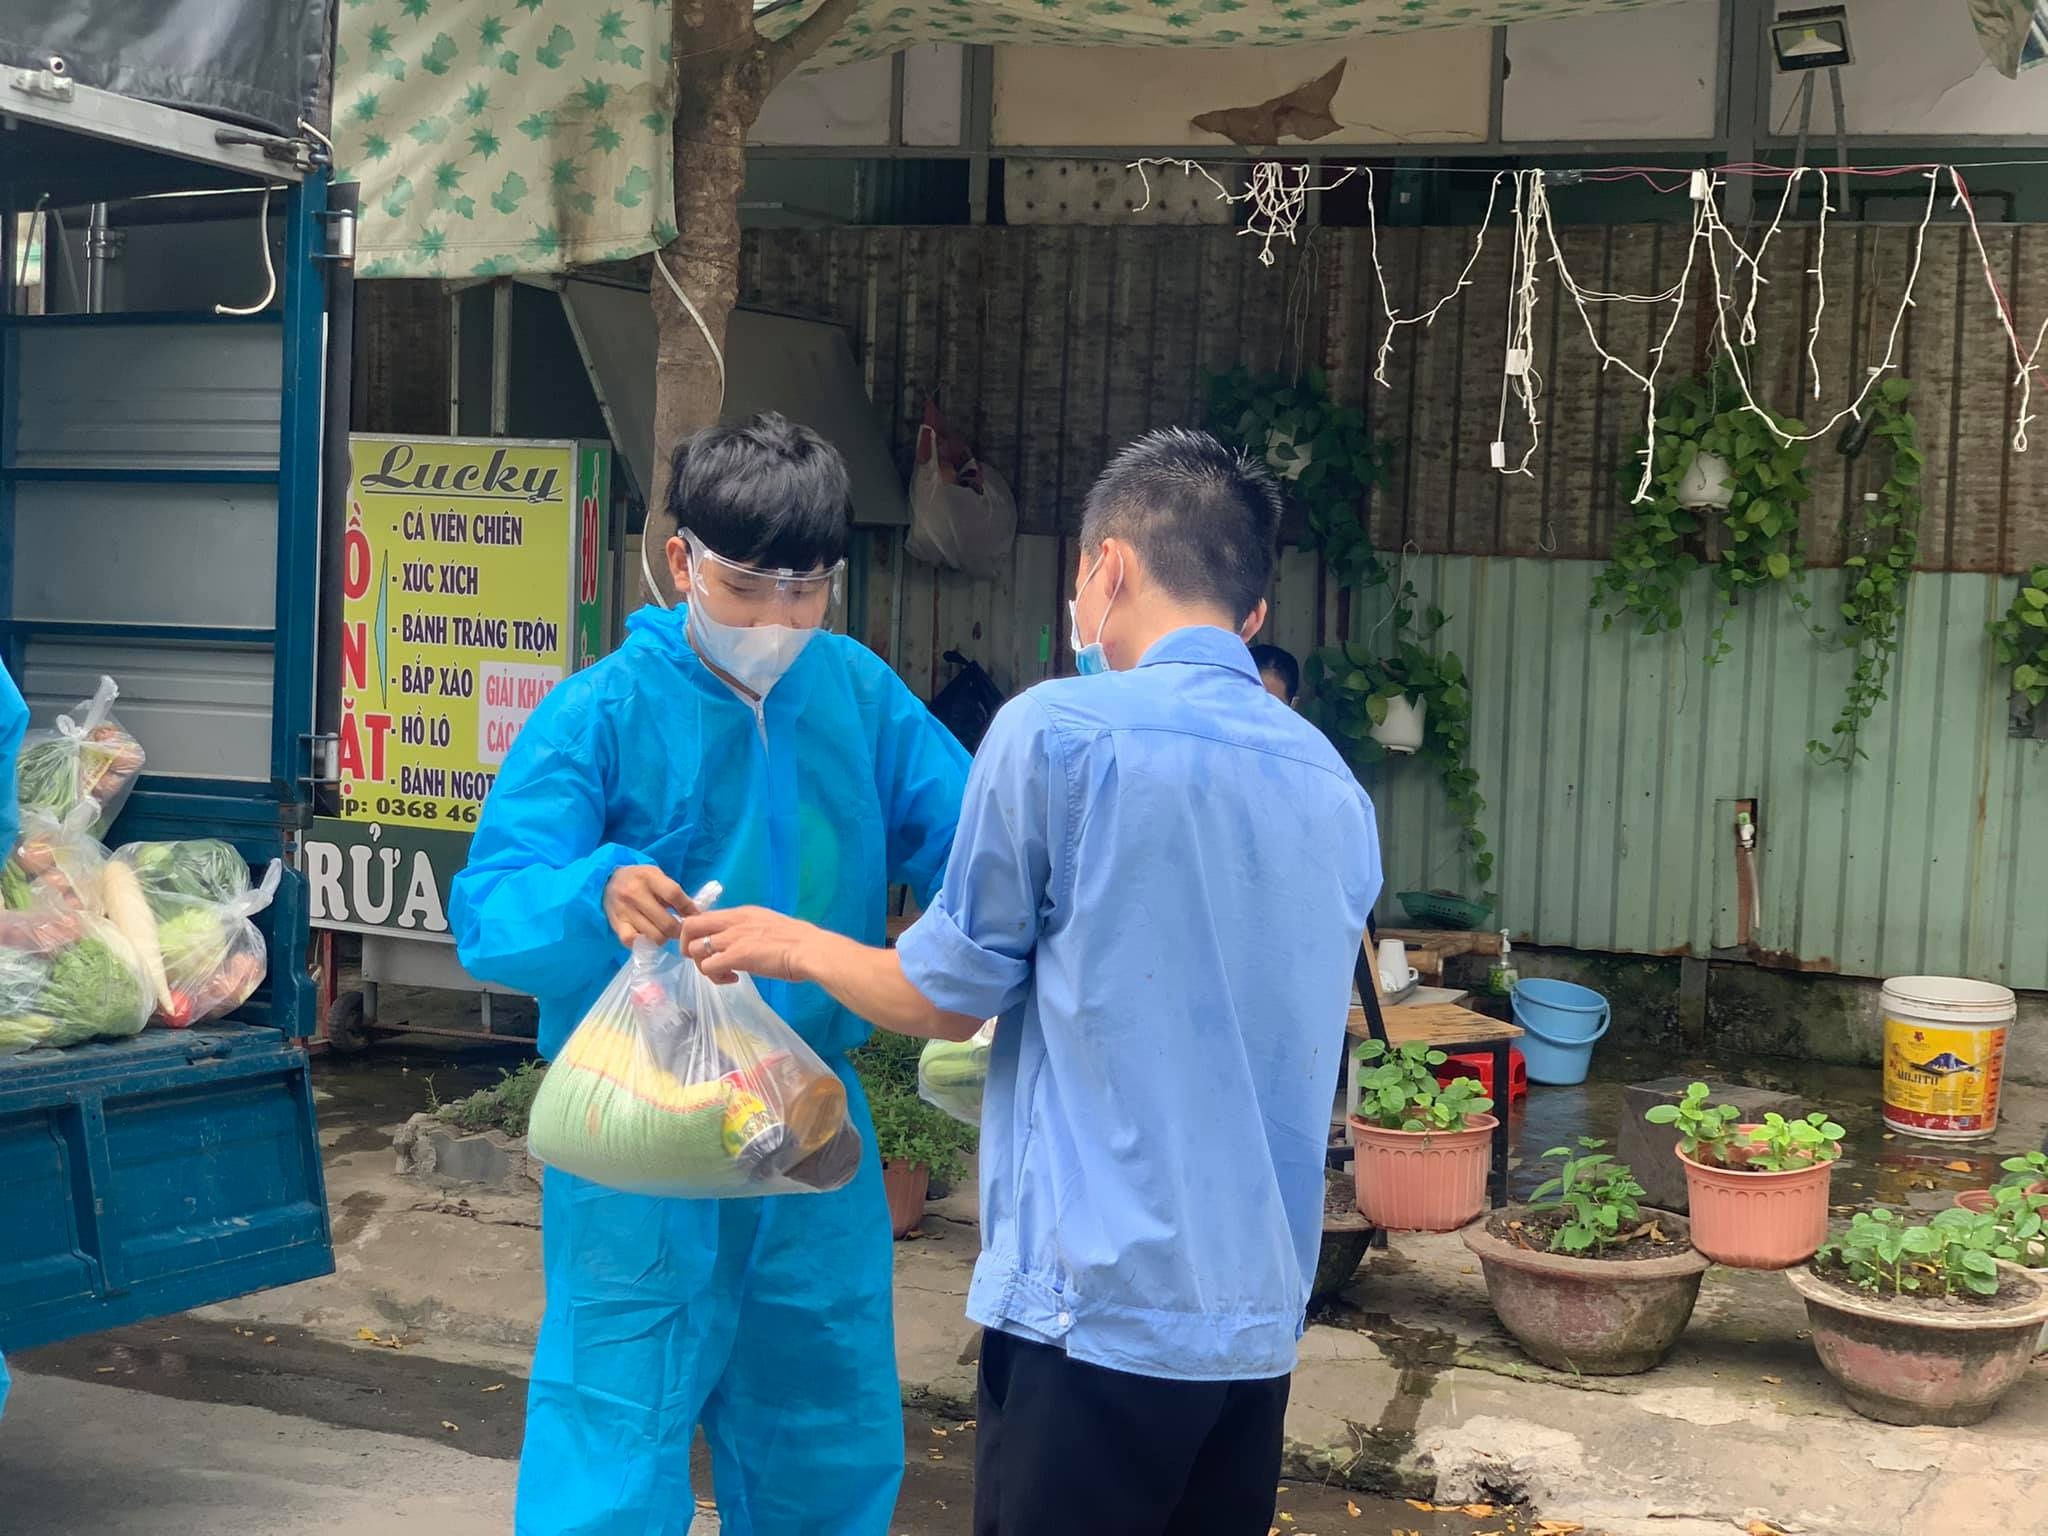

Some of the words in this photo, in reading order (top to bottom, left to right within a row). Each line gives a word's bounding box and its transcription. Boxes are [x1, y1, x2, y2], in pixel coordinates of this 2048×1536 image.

[361, 445, 562, 503] Lucky
[403, 507, 425, 541] CÁ
[430, 508, 467, 542] VIÊN
[473, 510, 522, 545] CHIÊN
[402, 557, 434, 592] XÚC
[439, 560, 478, 595] XÍCH
[402, 609, 447, 644] BÁNH
[453, 612, 507, 649] TRÁNG
[513, 617, 557, 657] TRỘN
[401, 655, 434, 694] BẮP
[439, 662, 472, 698] XÀO
[486, 668, 514, 707] GIẢI
[401, 706, 424, 745] HỒ
[430, 713, 450, 747] LÔ
[487, 715, 514, 752] CÁC
[401, 761, 445, 797] BÁNH
[451, 771, 495, 808] NGỌT
[376, 798, 437, 819] 0368
[304, 822, 448, 932] RỬA
